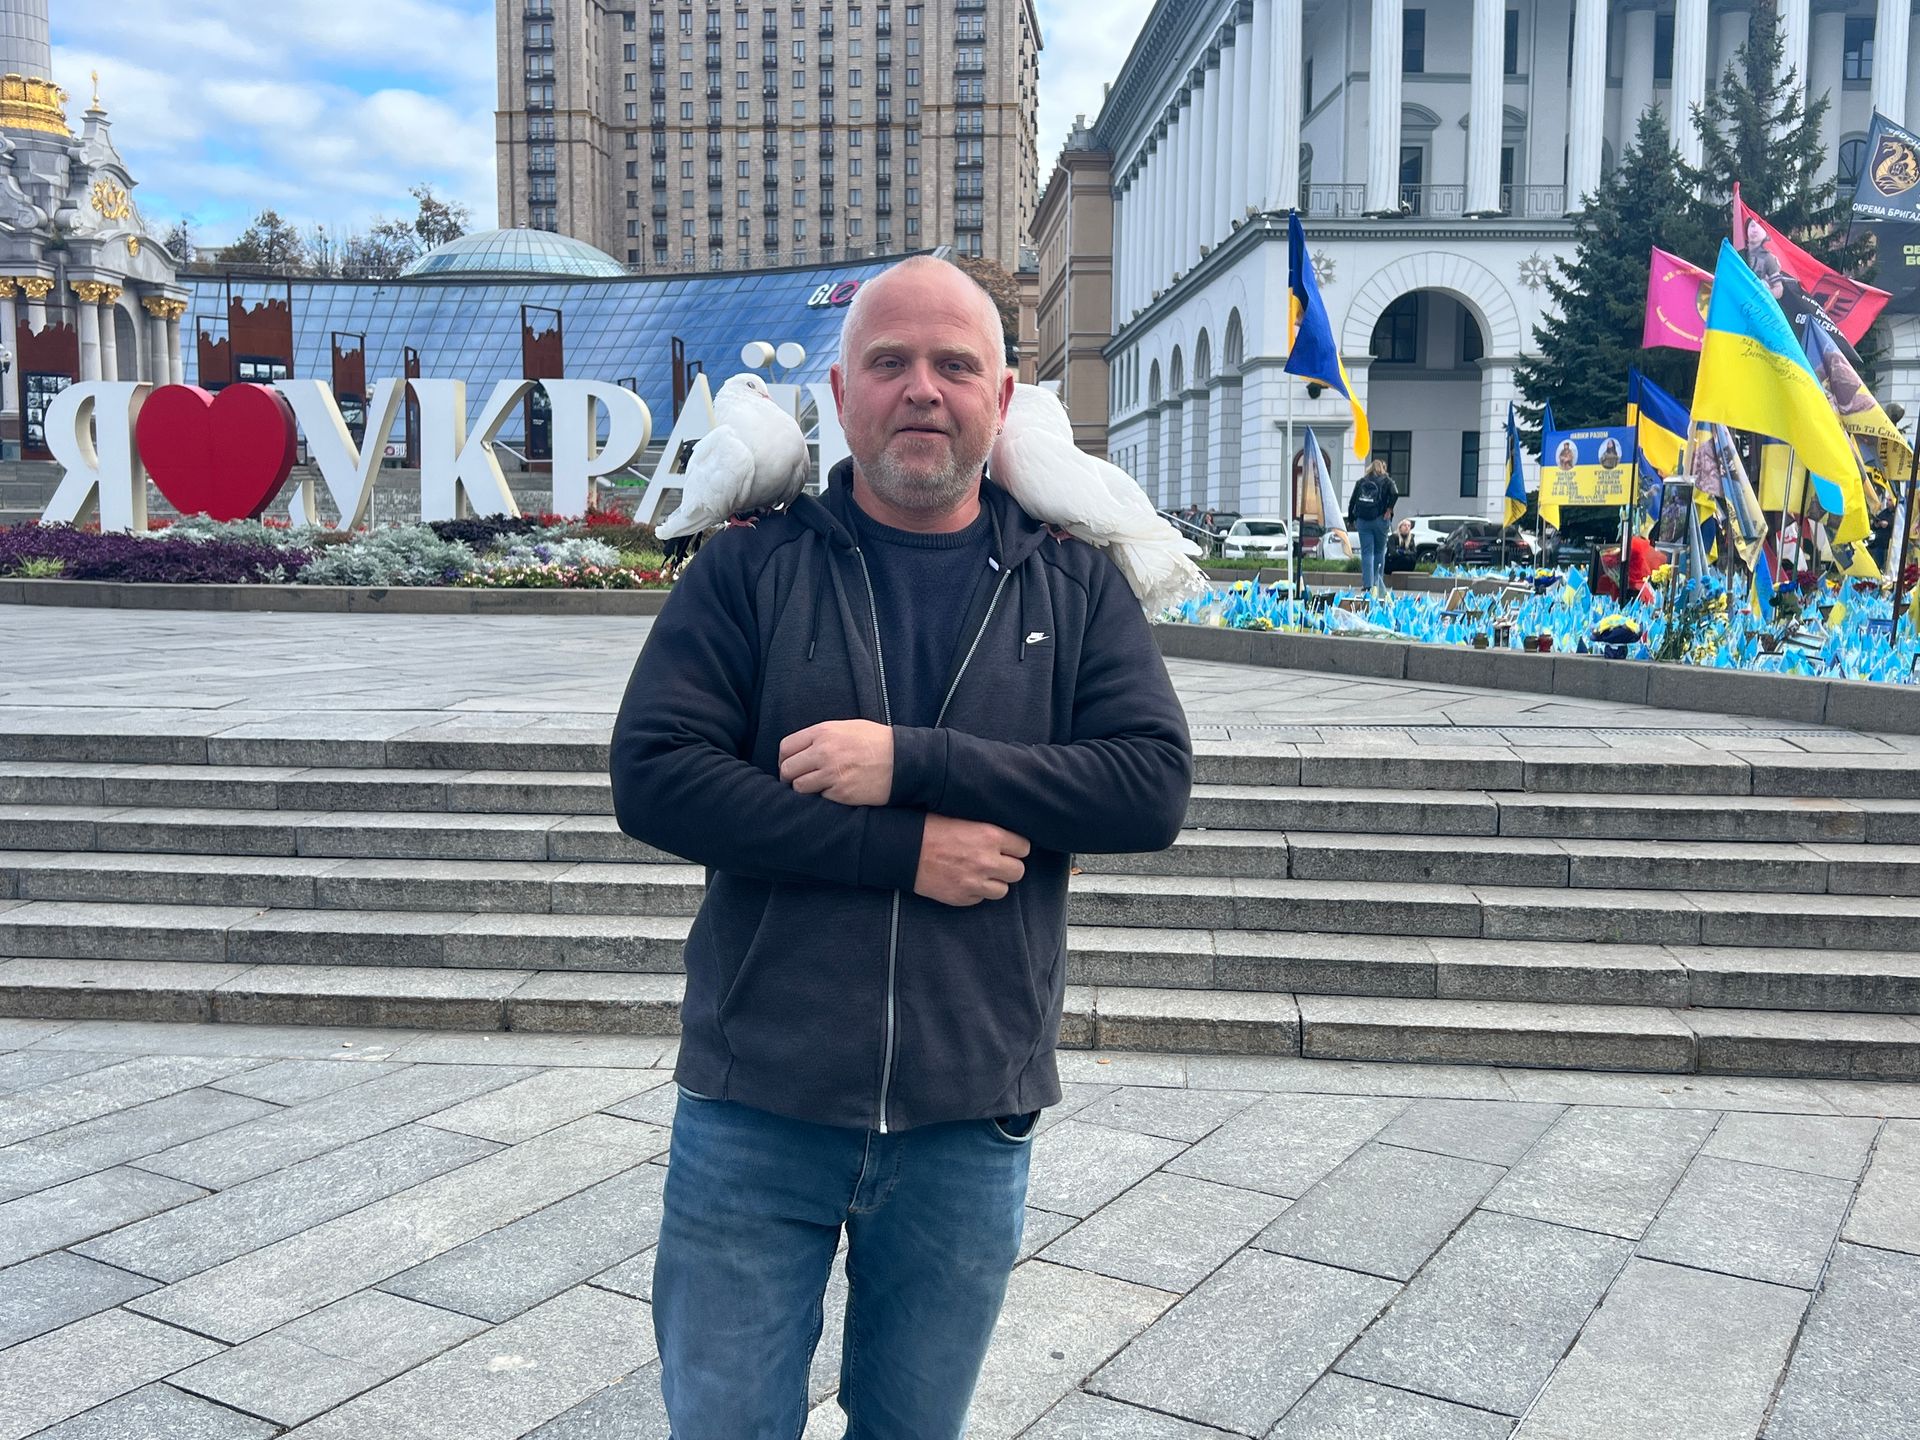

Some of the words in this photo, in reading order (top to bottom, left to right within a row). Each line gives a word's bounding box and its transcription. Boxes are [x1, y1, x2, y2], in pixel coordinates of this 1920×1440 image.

[1852, 203, 1886, 216] ОКРЕМА
[807, 279, 869, 306] GLO
[41, 381, 152, 532] Я
